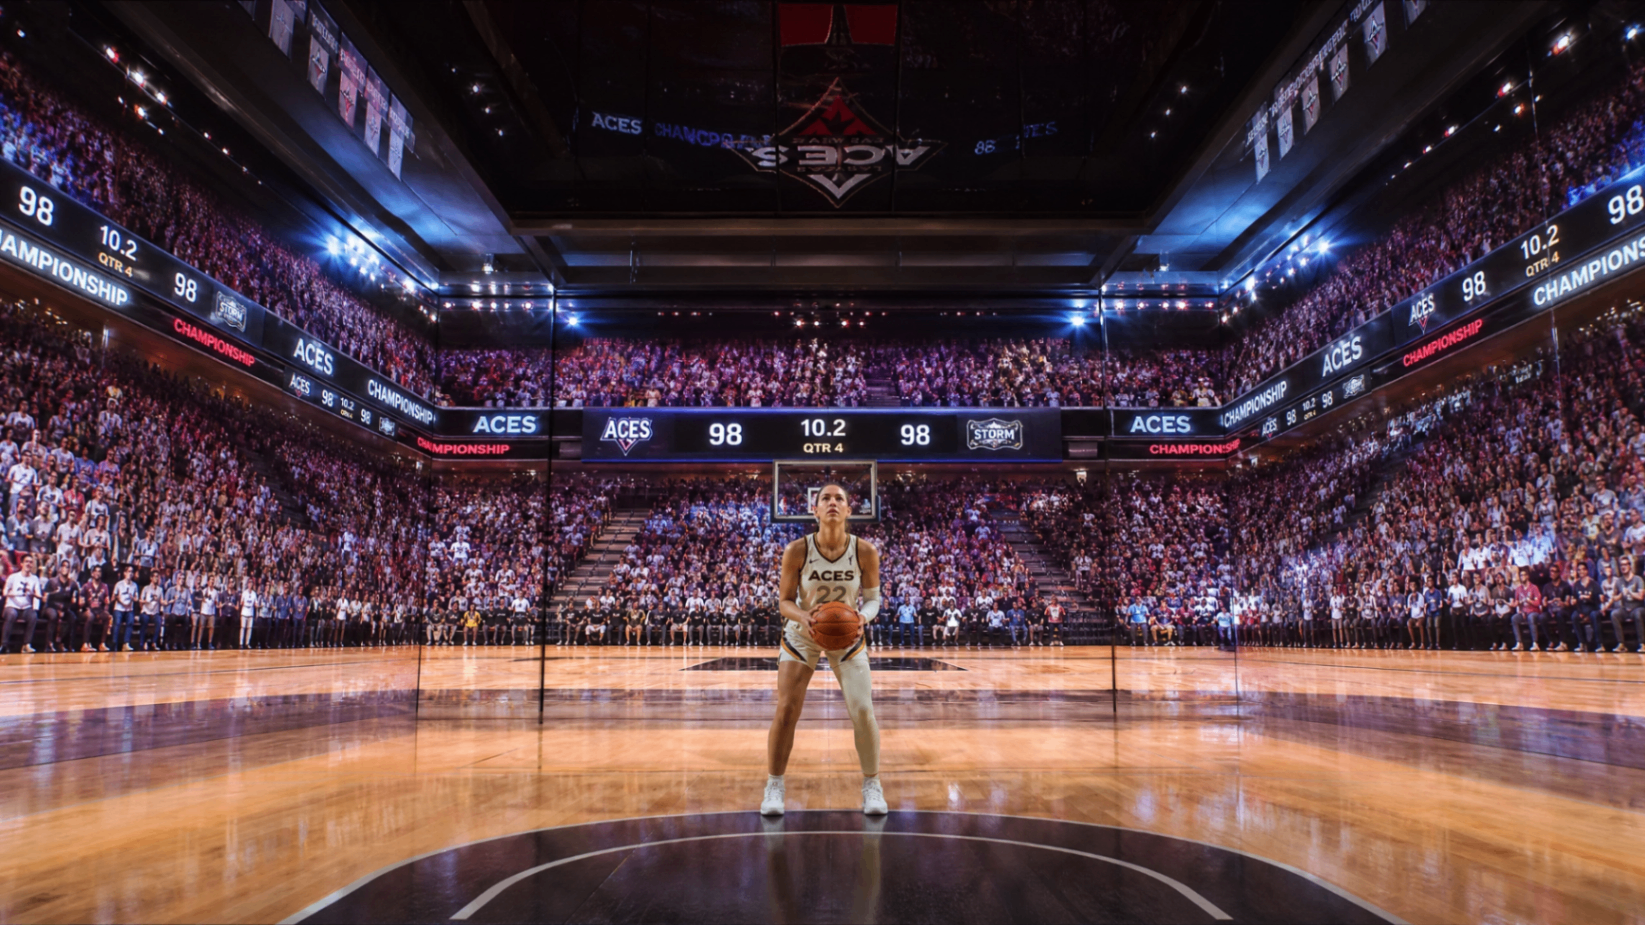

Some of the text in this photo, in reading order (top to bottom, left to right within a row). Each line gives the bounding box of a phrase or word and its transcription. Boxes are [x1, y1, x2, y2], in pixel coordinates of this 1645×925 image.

[591, 110, 643, 136] ACES
[745, 144, 931, 167] ACES
[18, 186, 54, 226] 98
[1607, 184, 1645, 225] 98
[100, 225, 137, 261] 10.2
[1520, 224, 1560, 260] 10.2
[0, 228, 128, 306] AMPIONSHIP
[98, 252, 133, 278] QTR 4
[1525, 250, 1560, 278] QTR 4
[174, 272, 197, 303] 98
[1462, 271, 1486, 302] 98
[1409, 295, 1435, 324] ACES
[173, 318, 255, 366] CHAMPIONSHIP
[1403, 318, 1483, 367] CHAMPIONSHIP
[293, 338, 334, 376] ACES
[1322, 336, 1363, 377] ACES
[289, 373, 311, 394] ACES
[322, 390, 334, 407] 98
[367, 379, 433, 425] CHAMPIONSHIP
[1224, 381, 1287, 428] CHAMPIONSHIP
[1302, 397, 1316, 412] 10.2
[1322, 390, 1333, 409] 98
[360, 408, 371, 425] 98
[472, 415, 537, 433] ACES
[800, 418, 846, 437] 10.2
[1130, 415, 1192, 433] ACES
[1261, 418, 1277, 437] ACES
[1286, 409, 1297, 426] 98
[603, 419, 651, 439] ACES
[709, 423, 743, 446] 98
[900, 424, 931, 446] 98
[974, 429, 1015, 440] STORM
[803, 442, 844, 453] QTR 4
[808, 570, 855, 582] ACES
[816, 585, 847, 604] 22
